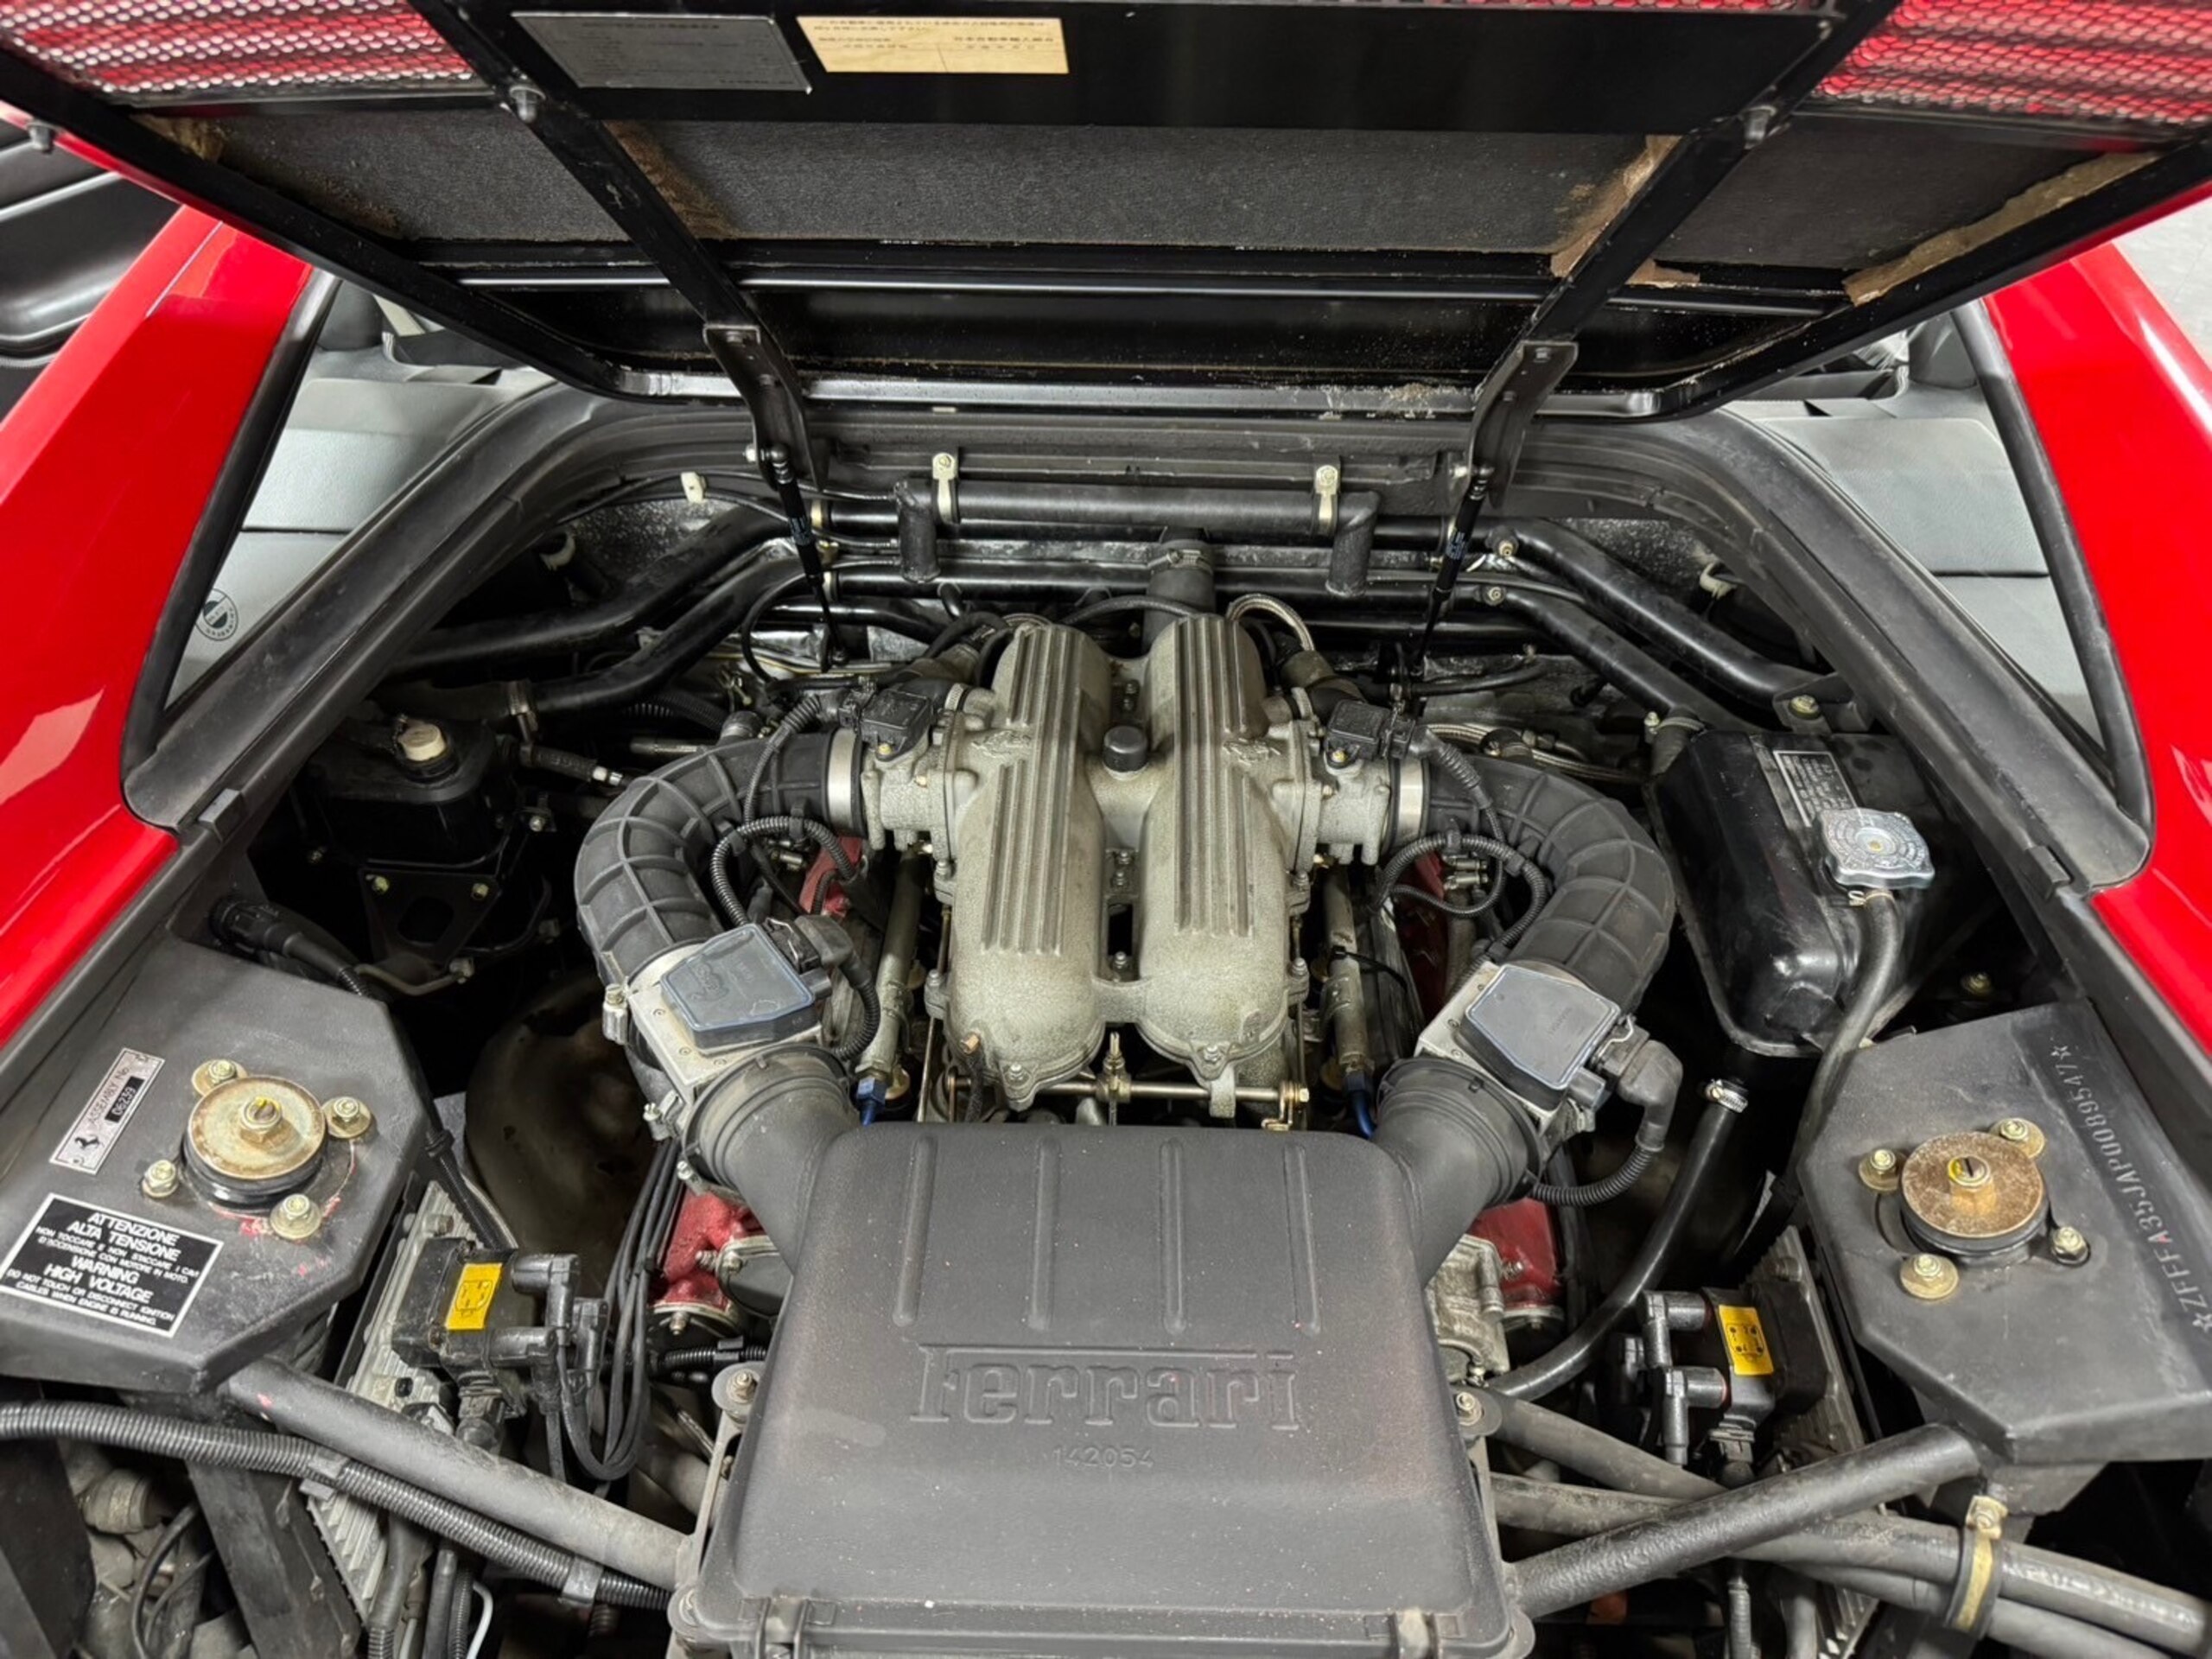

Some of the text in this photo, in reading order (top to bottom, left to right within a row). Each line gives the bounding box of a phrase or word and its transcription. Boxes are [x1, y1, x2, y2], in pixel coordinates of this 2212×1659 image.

[67, 1220, 181, 1262] ALTA TENSIONE
[87, 1211, 180, 1247] ATTENZIONE
[6, 1268, 22, 1279] DO
[22, 1273, 41, 1284] NOT
[71, 1286, 87, 1297] OR
[43, 1263, 154, 1305] HIGH VOLTAGE
[71, 1255, 140, 1285] WARNING
[910, 1344, 1299, 1430] Ferrari
[1053, 1446, 1155, 1468] 142054
